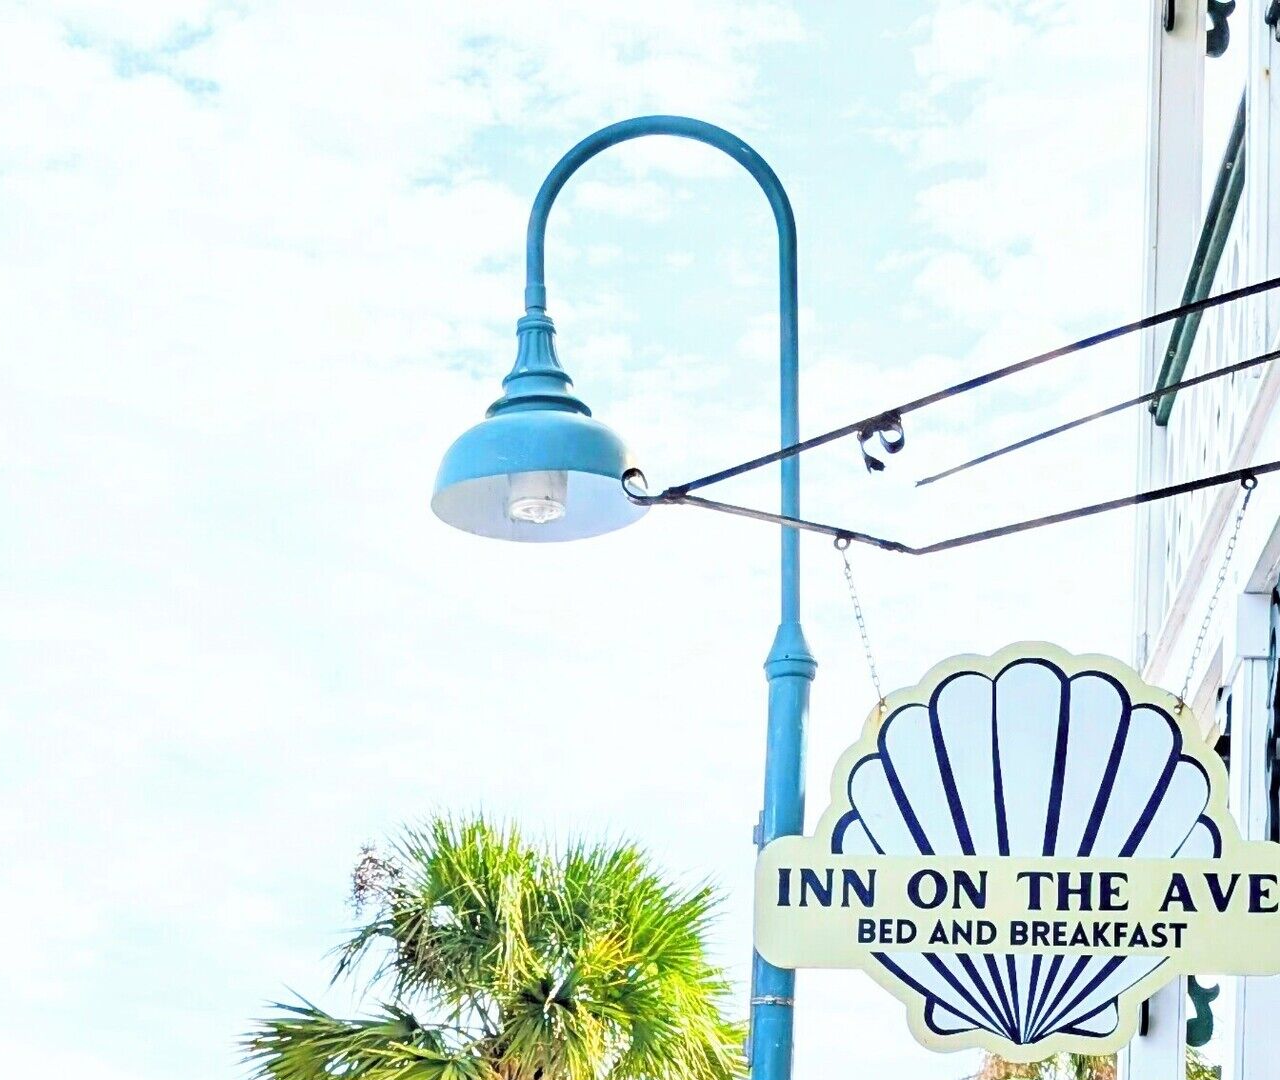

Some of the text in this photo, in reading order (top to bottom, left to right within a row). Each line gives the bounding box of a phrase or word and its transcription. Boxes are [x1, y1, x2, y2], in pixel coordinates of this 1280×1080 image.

[776, 867, 1280, 914] INN ON THE AVE
[857, 917, 1189, 950] BED AND BREAKFAST
